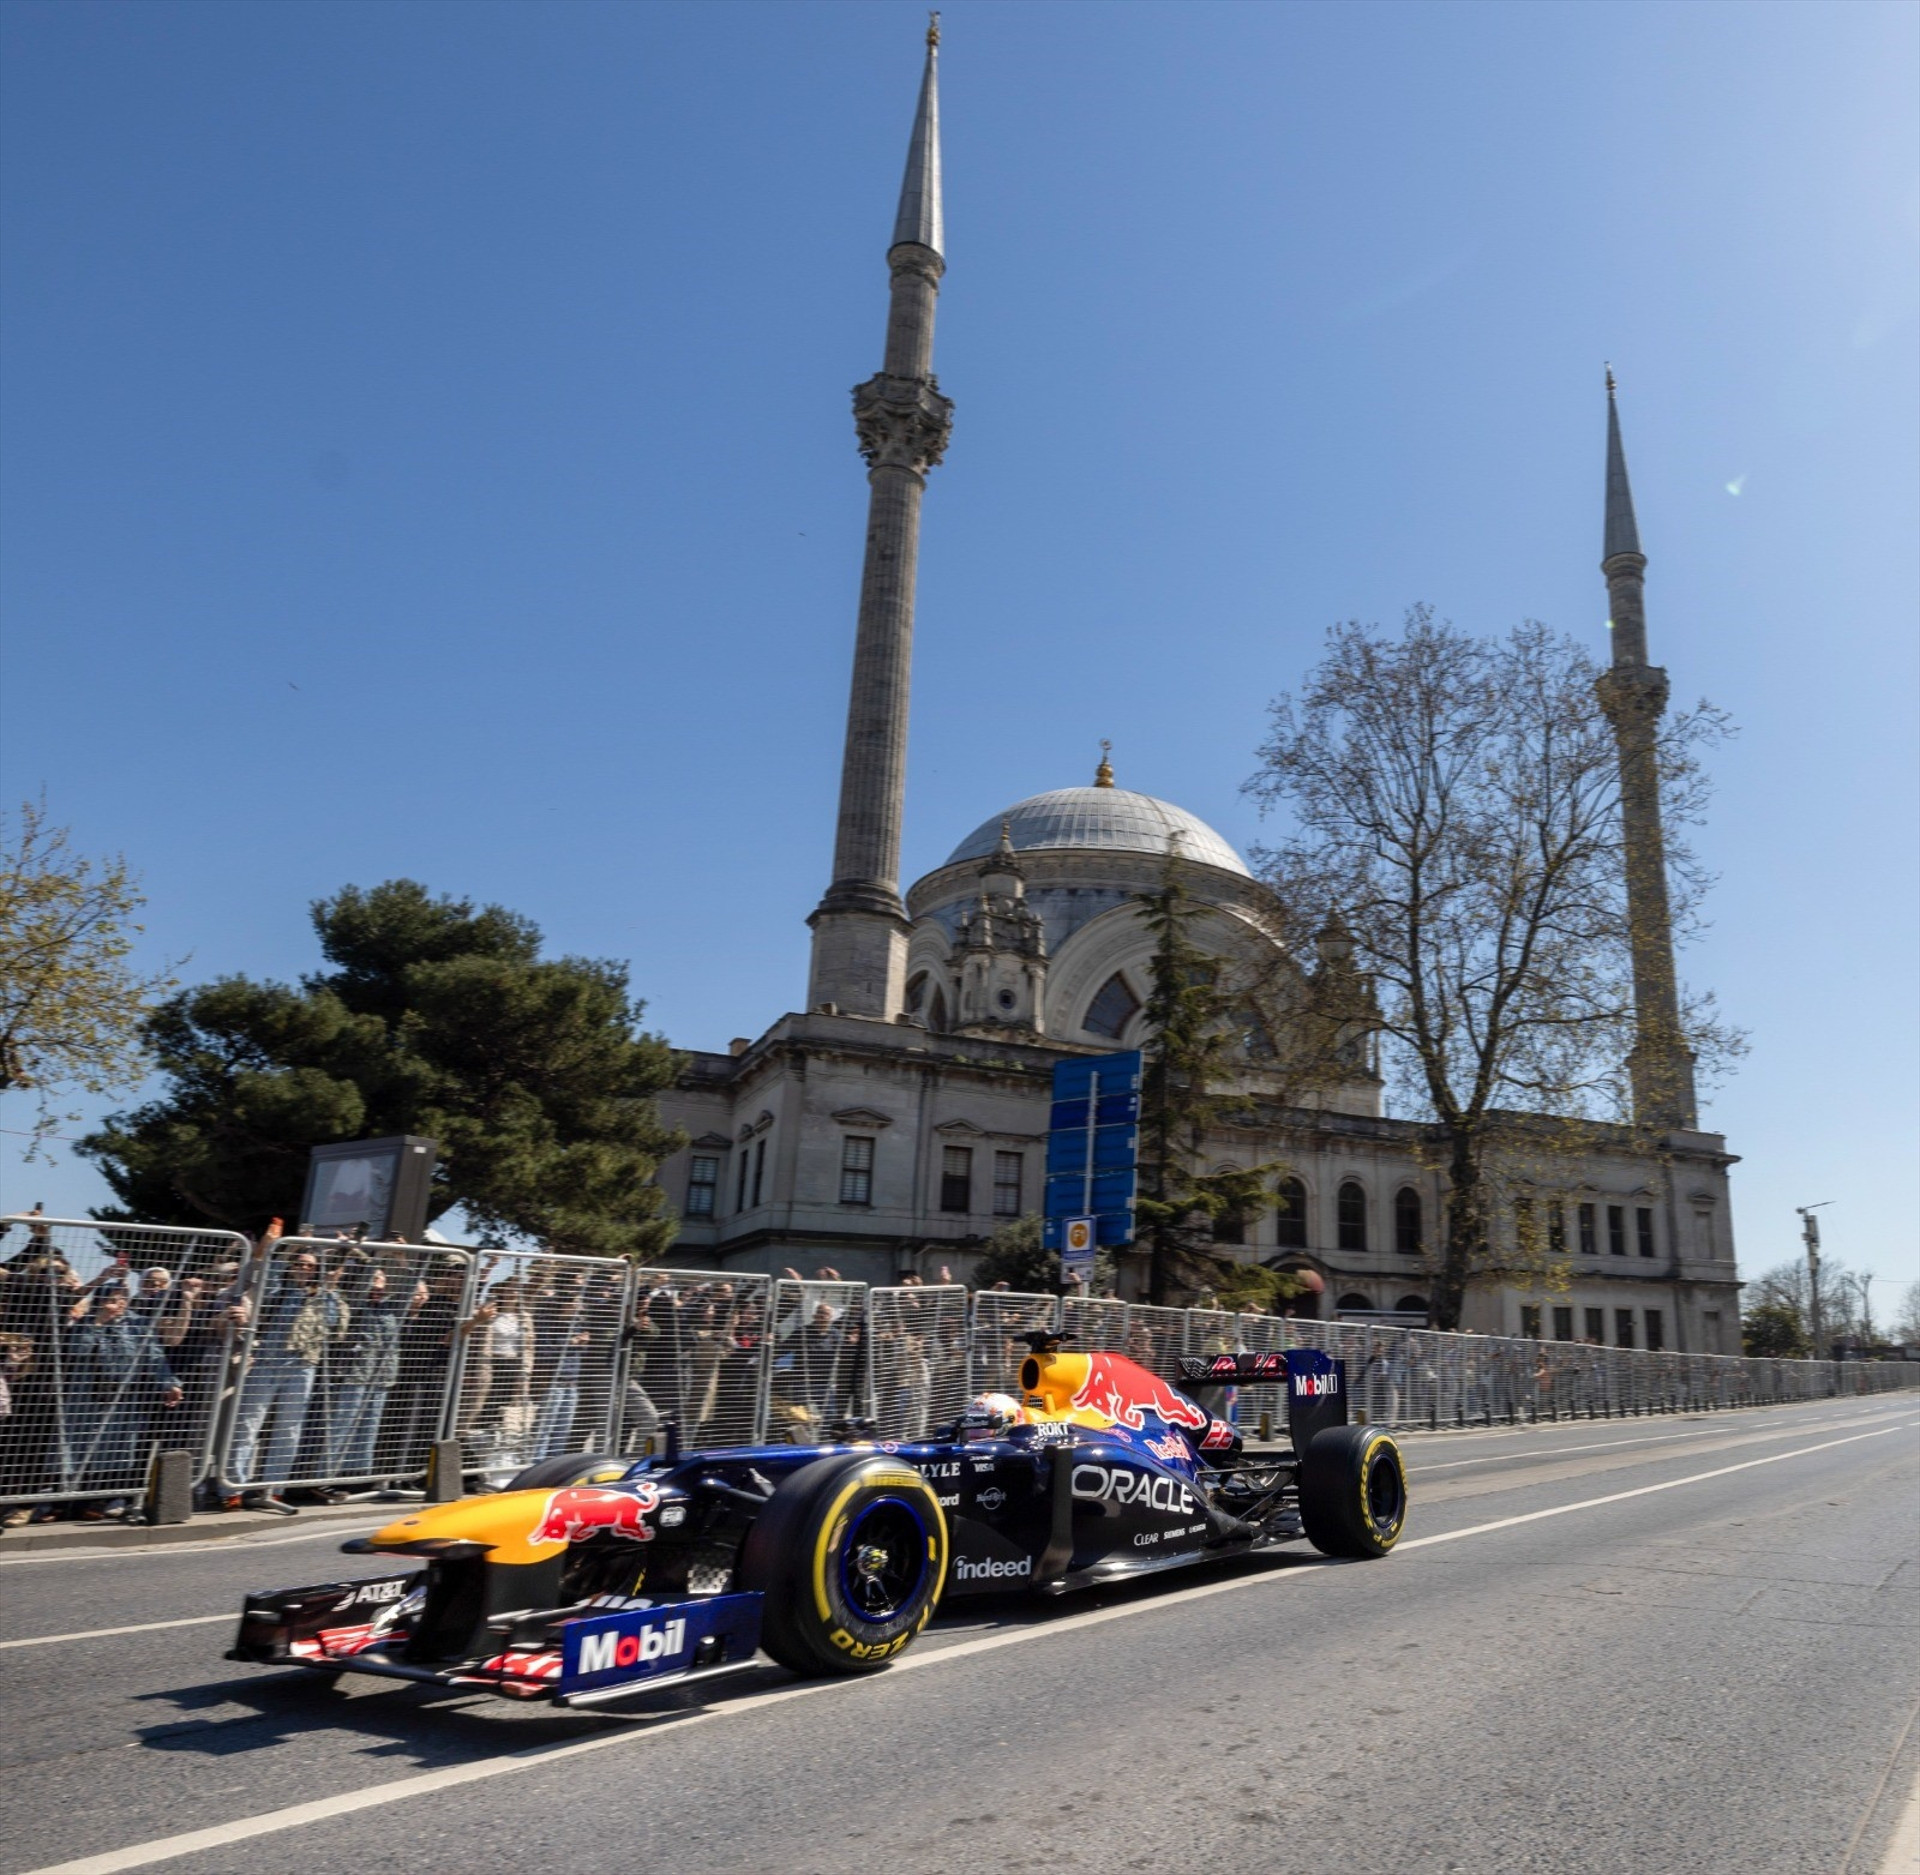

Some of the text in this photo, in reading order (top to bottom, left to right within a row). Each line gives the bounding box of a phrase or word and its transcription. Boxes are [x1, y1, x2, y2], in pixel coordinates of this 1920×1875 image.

[1294, 1375, 1327, 1396] Mobil
[1037, 1422, 1069, 1436] ROKT
[1071, 1464, 1194, 1515] ORACLE
[1133, 1532, 1159, 1546] CLEAR
[956, 1555, 1032, 1580] indeed
[577, 1617, 687, 1676] Mobil
[829, 1627, 909, 1660] ZERO
